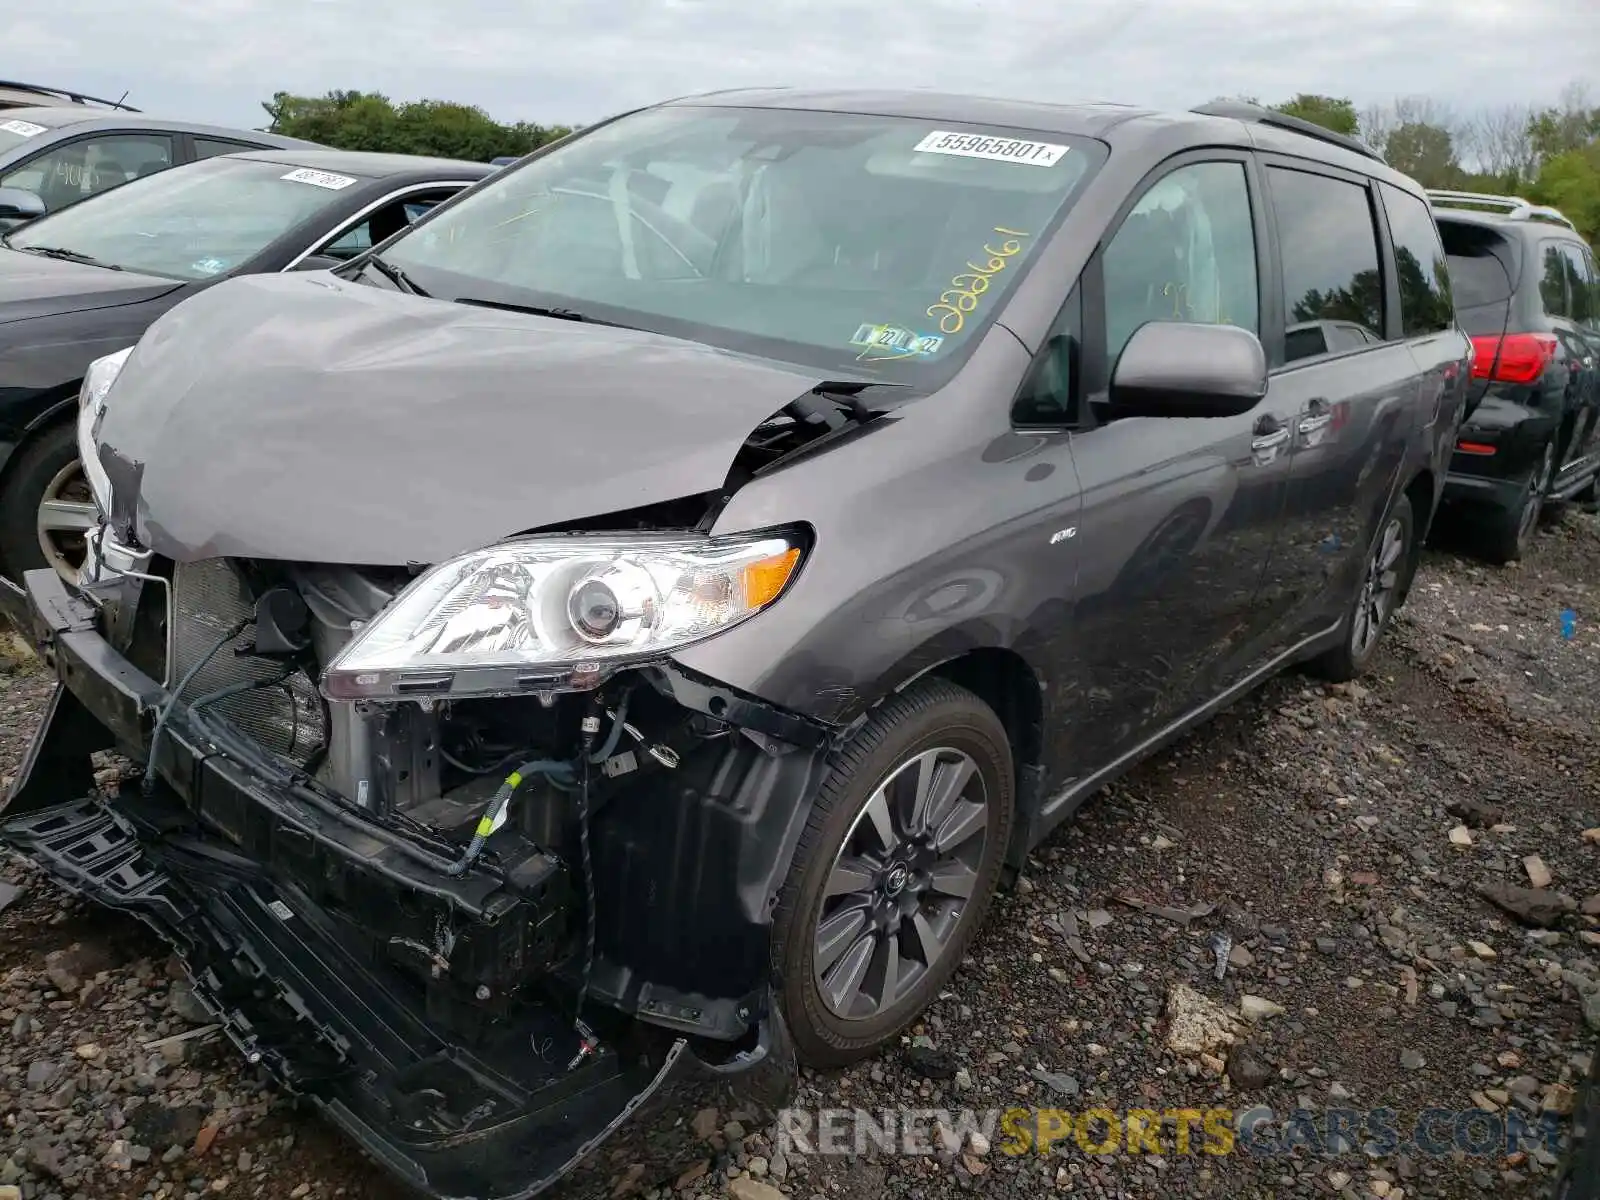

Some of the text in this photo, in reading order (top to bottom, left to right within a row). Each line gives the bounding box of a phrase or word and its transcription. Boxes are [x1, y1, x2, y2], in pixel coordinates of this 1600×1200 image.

[936, 134, 1046, 160] 55965801
[926, 226, 1030, 334] 222661
[878, 329, 898, 346] 22
